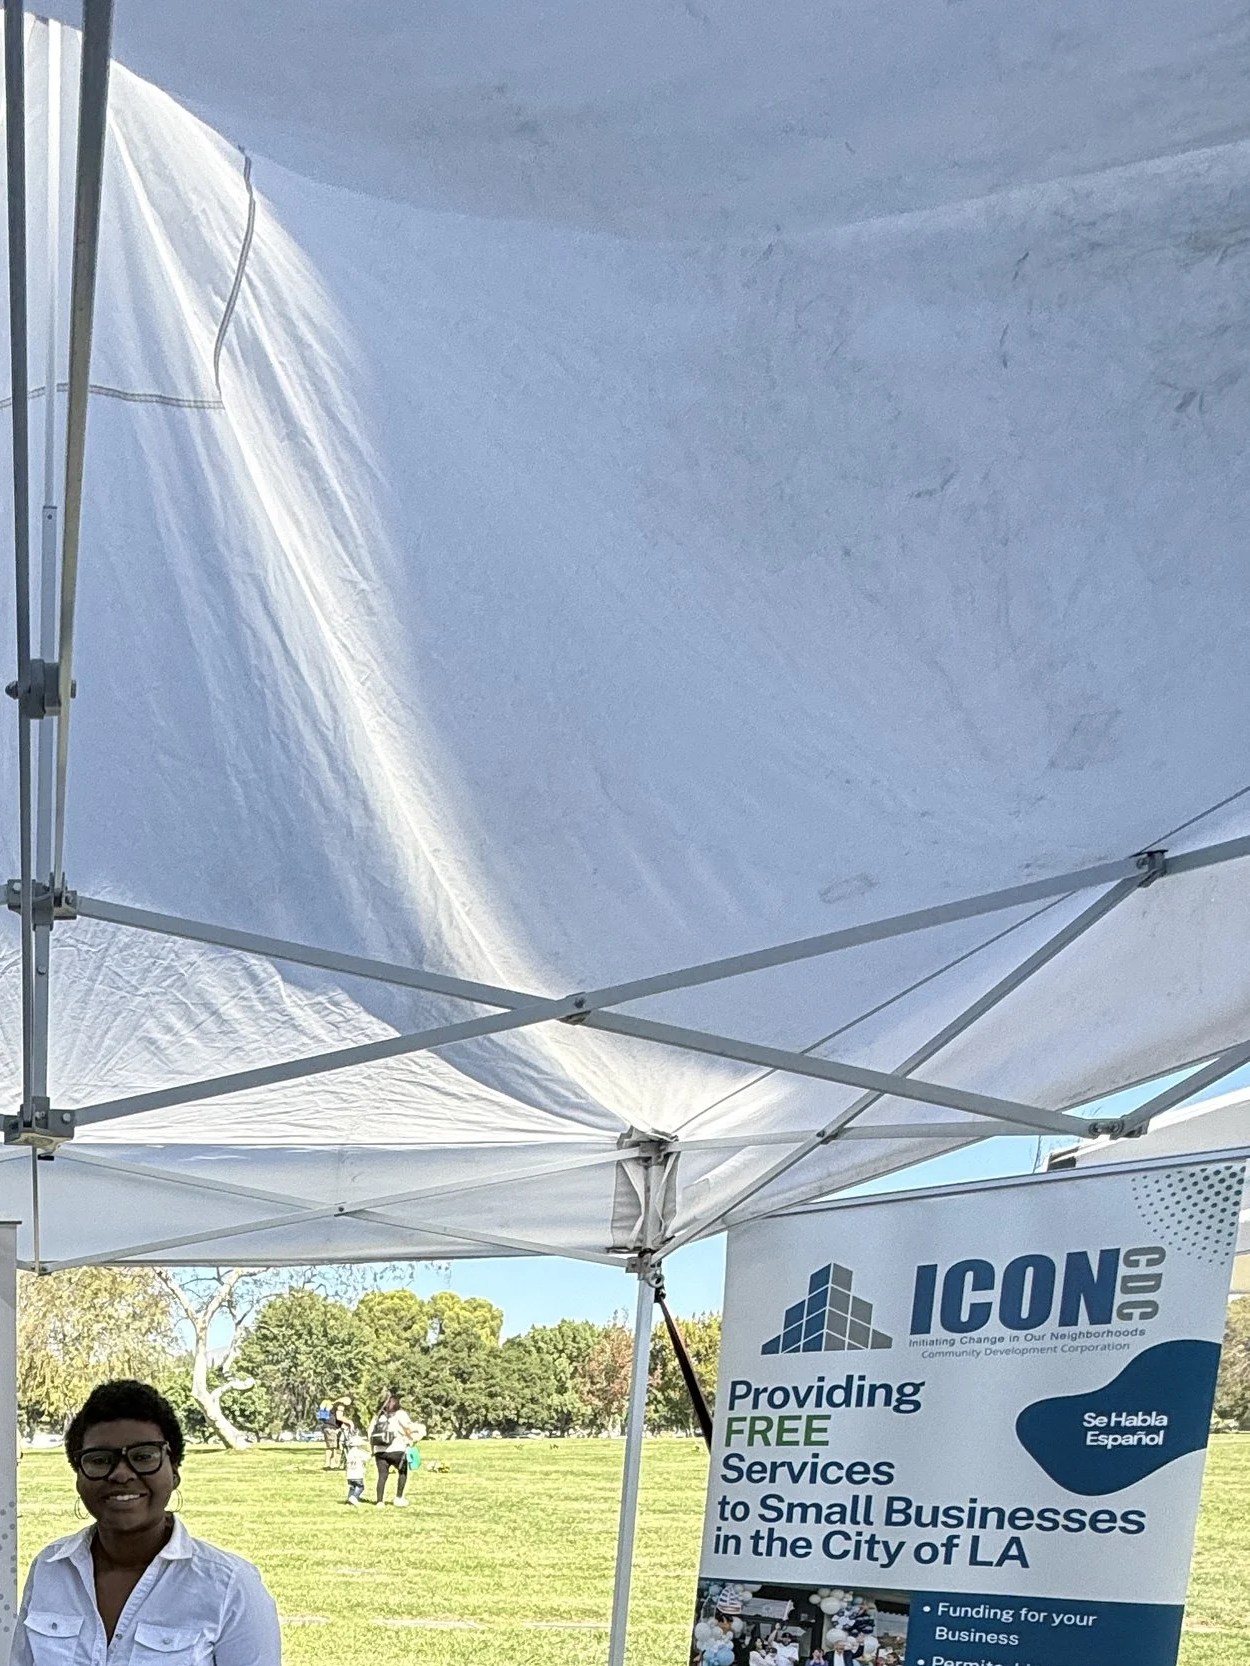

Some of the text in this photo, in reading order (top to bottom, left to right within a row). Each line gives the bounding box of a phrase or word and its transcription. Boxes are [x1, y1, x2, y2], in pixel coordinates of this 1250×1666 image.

[909, 1246, 1166, 1336] ICON CDC
[909, 1328, 1146, 1347] Initiating Change in Our Neighborhoods
[922, 1343, 1129, 1359] Community Development Corporation
[729, 1374, 925, 1415] Providing
[724, 1415, 831, 1447] FREE
[1083, 1412, 1168, 1427] Se Habla
[1086, 1430, 1164, 1450] Español
[721, 1454, 895, 1485] Services
[718, 1495, 1146, 1535] to Small Businesses
[713, 1528, 1030, 1569] in the City of LA
[937, 1603, 1096, 1628] Funding for your
[935, 1628, 1019, 1646] Business
